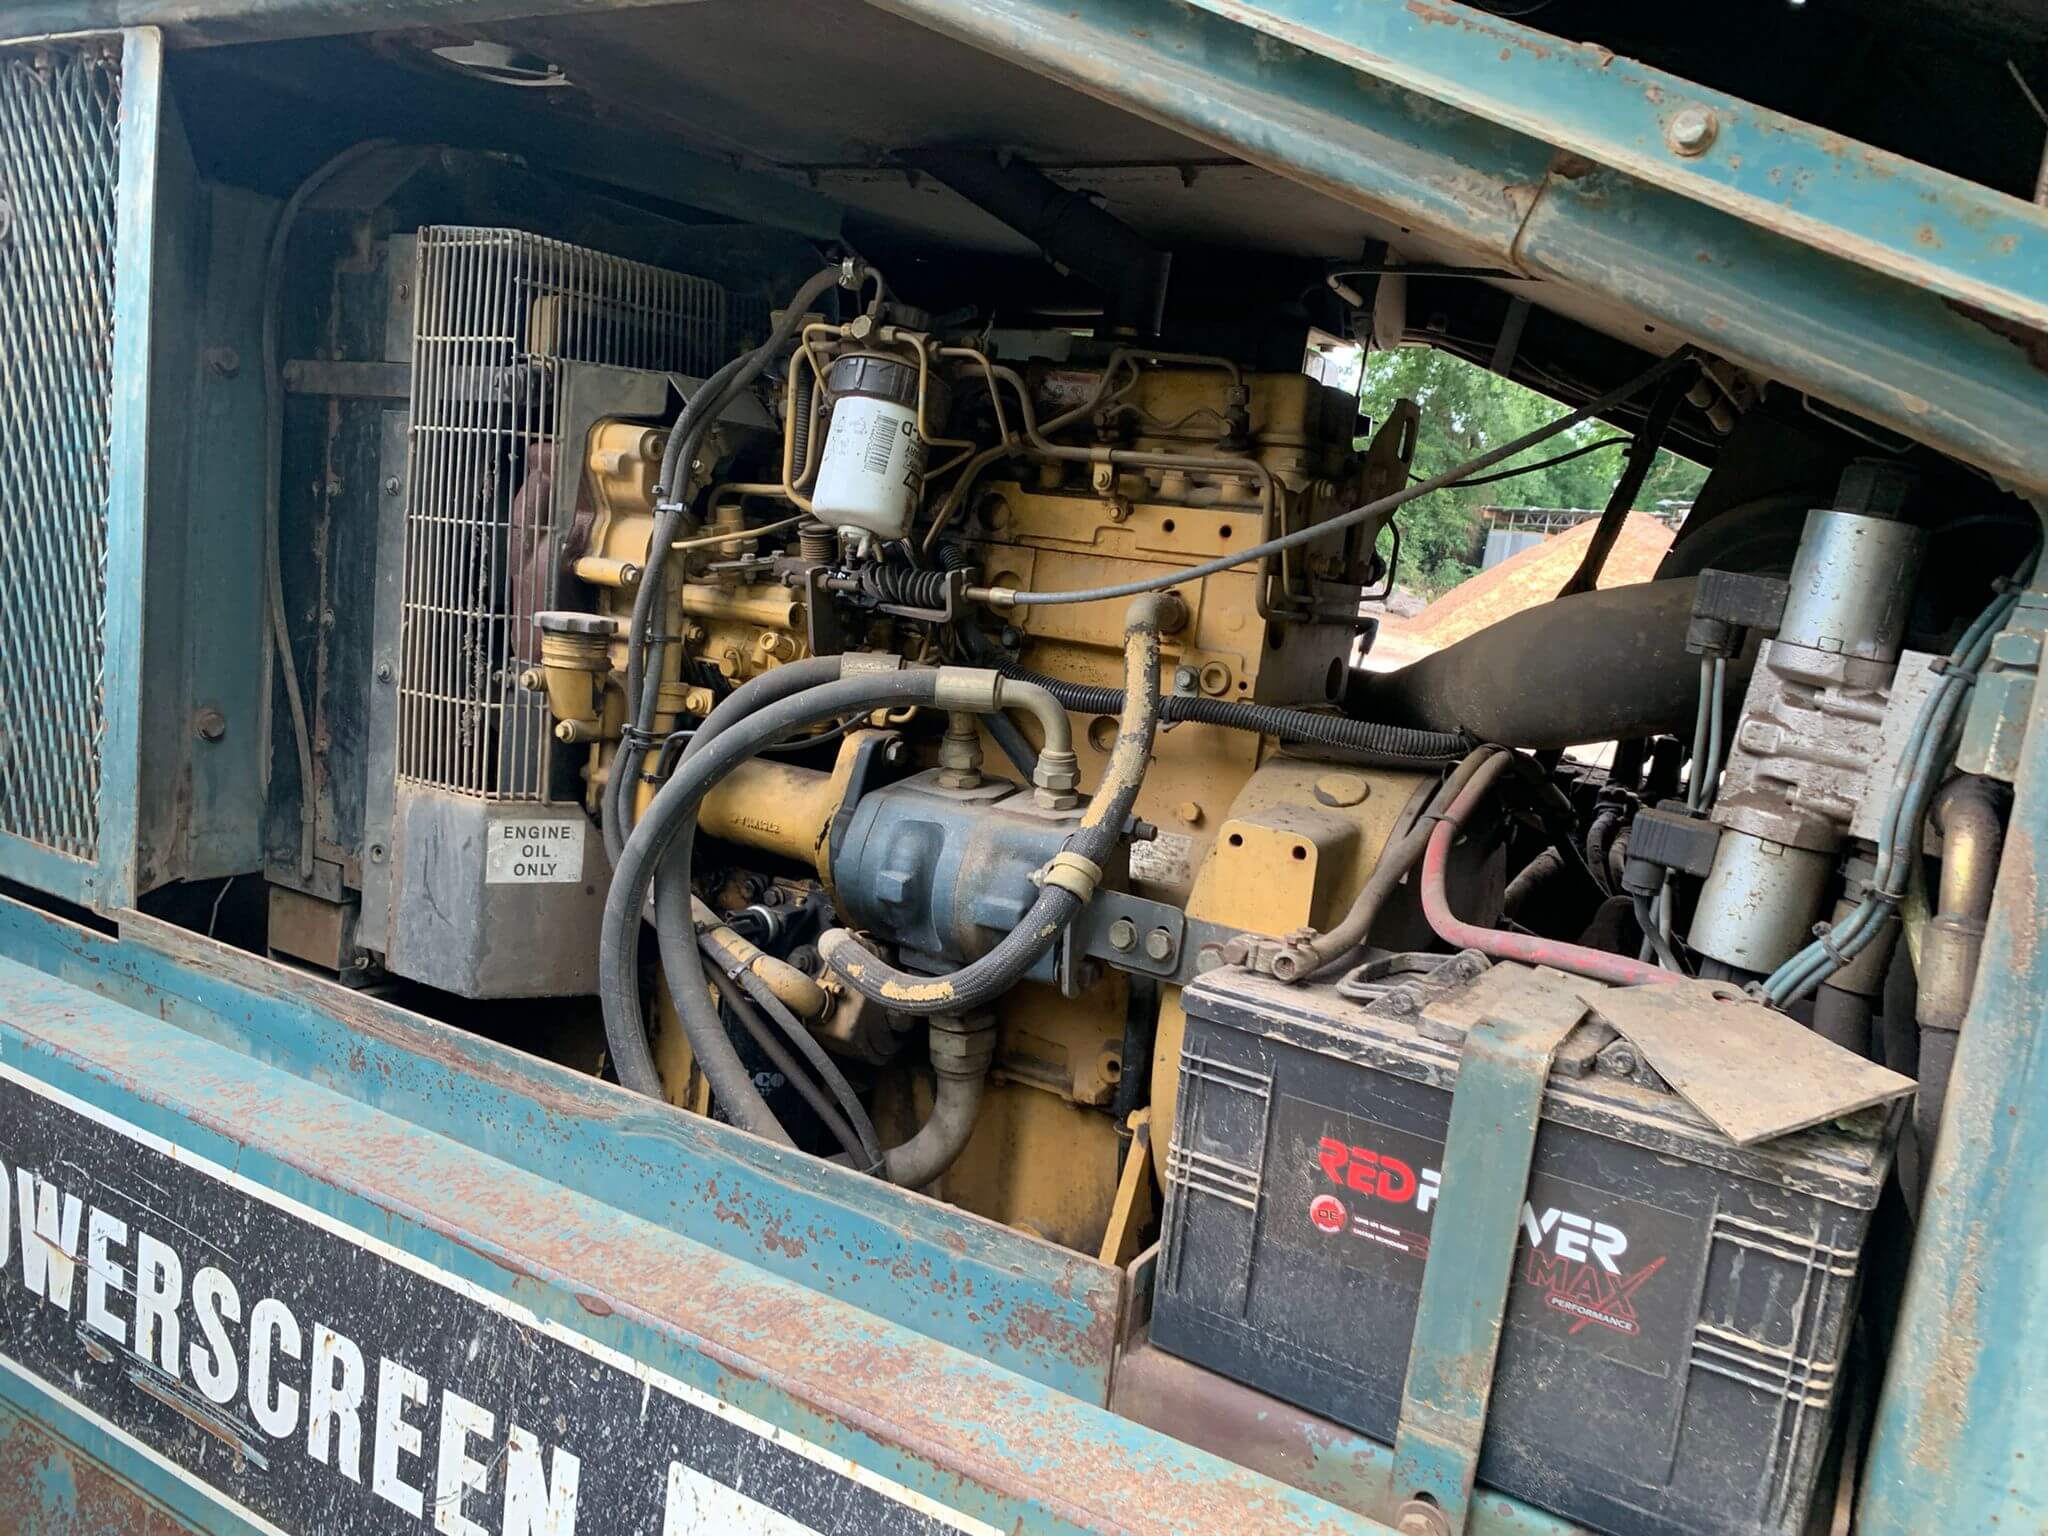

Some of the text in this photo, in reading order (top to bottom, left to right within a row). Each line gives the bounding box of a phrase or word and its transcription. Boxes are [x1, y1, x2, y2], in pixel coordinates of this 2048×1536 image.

[504, 826, 571, 839] ENGINE
[522, 845, 550, 858] OIL
[513, 863, 557, 876] ONLY
[1527, 1248, 1667, 1322] MAX
[1551, 1297, 1634, 1331] PERFORMANCE
[0, 1158, 581, 1536] WERSCREEN
